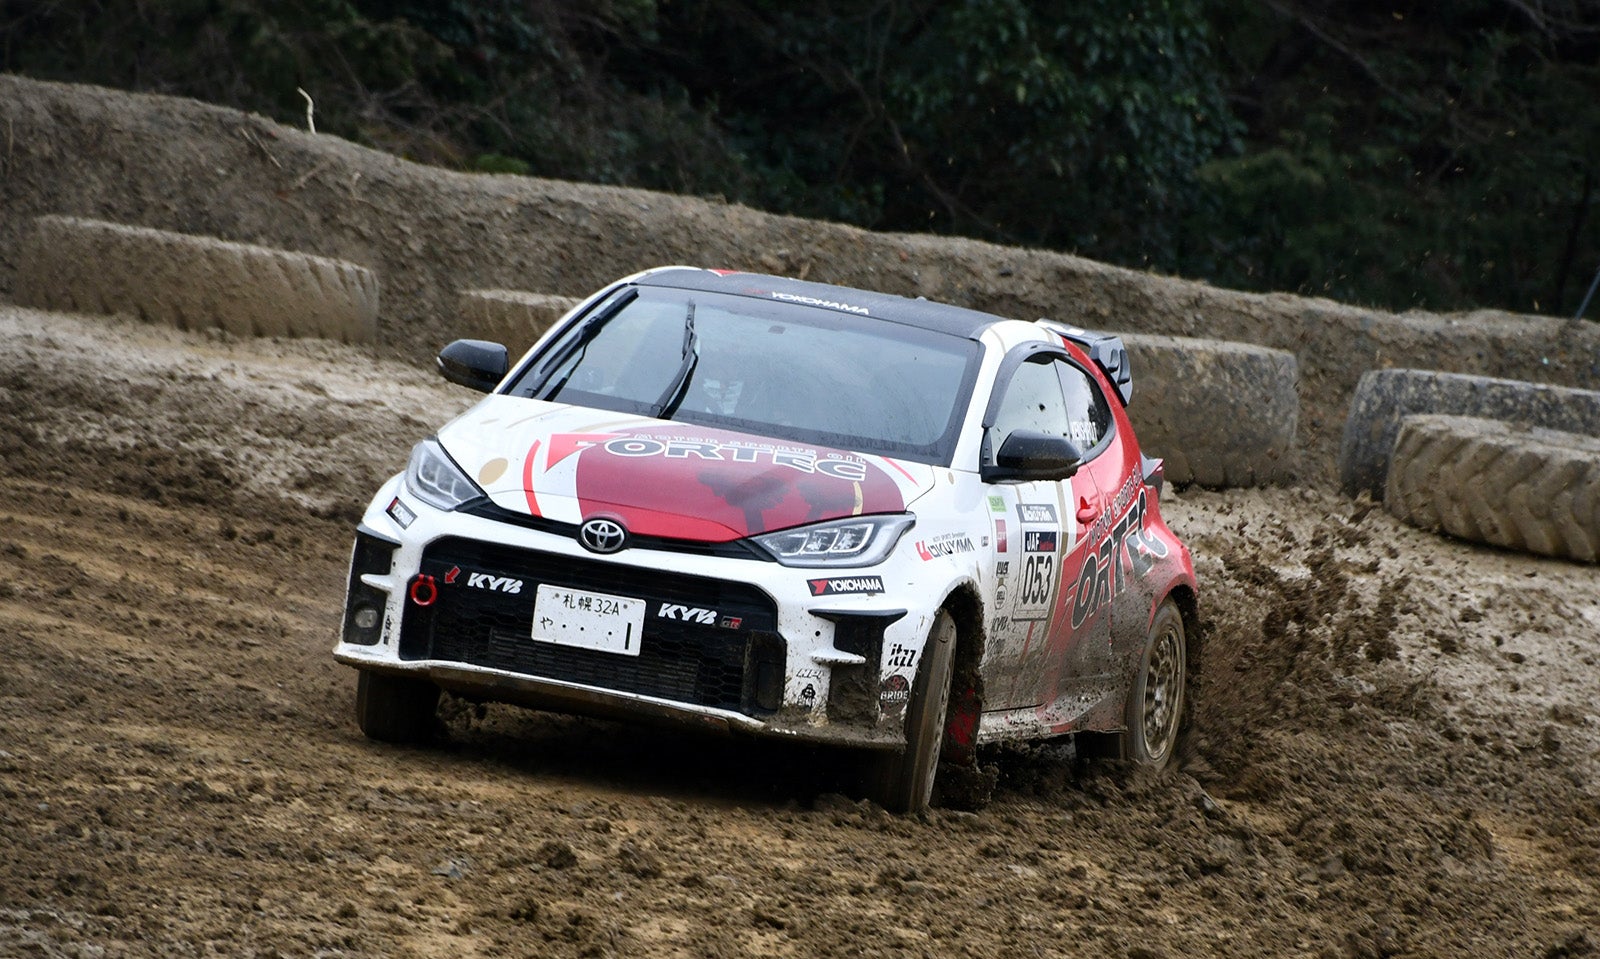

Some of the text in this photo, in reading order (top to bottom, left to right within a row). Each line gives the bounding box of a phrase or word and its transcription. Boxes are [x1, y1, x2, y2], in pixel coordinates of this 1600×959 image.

[771, 291, 870, 315] YOKOHAMA
[1026, 532, 1040, 551] JAF
[467, 572, 524, 594] KYB
[829, 578, 883, 592] YOKOHAMA
[1022, 555, 1053, 605] 053
[540, 616, 553, 630] や
[658, 602, 718, 625] KYB
